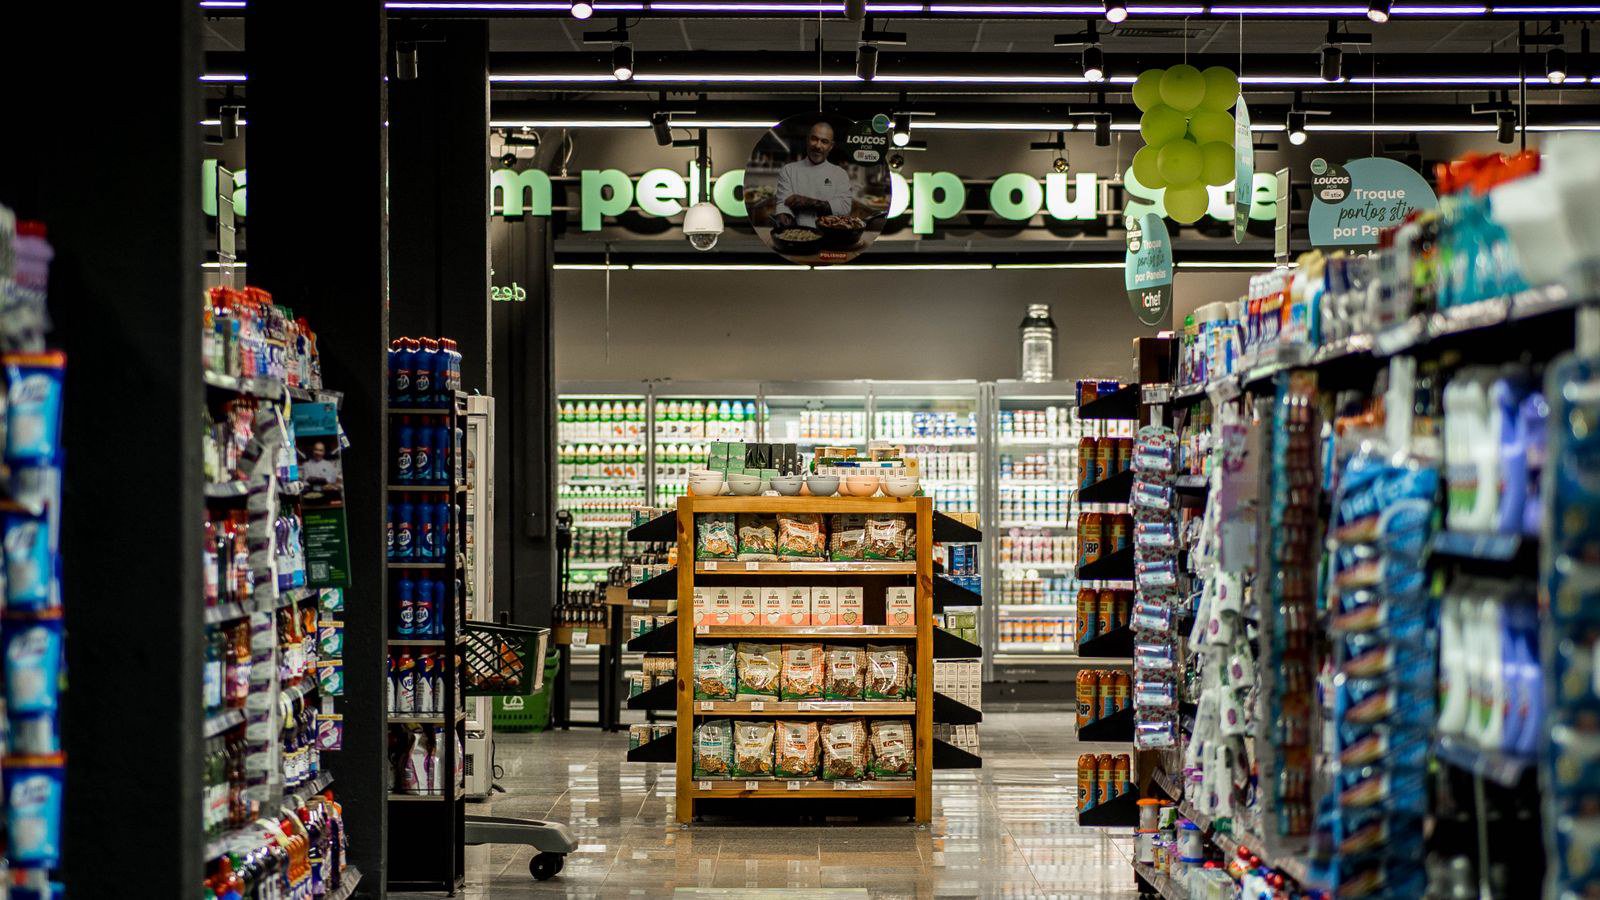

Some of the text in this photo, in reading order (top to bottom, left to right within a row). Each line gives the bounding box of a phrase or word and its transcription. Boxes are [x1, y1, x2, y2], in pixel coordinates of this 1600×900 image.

[847, 136, 886, 145] LOUCOS
[1313, 176, 1350, 185] LOUCOS
[989, 172, 1098, 221] ou
[1353, 188, 1406, 202] Troque
[1337, 199, 1415, 228] pontos stix
[1333, 226, 1358, 241] por
